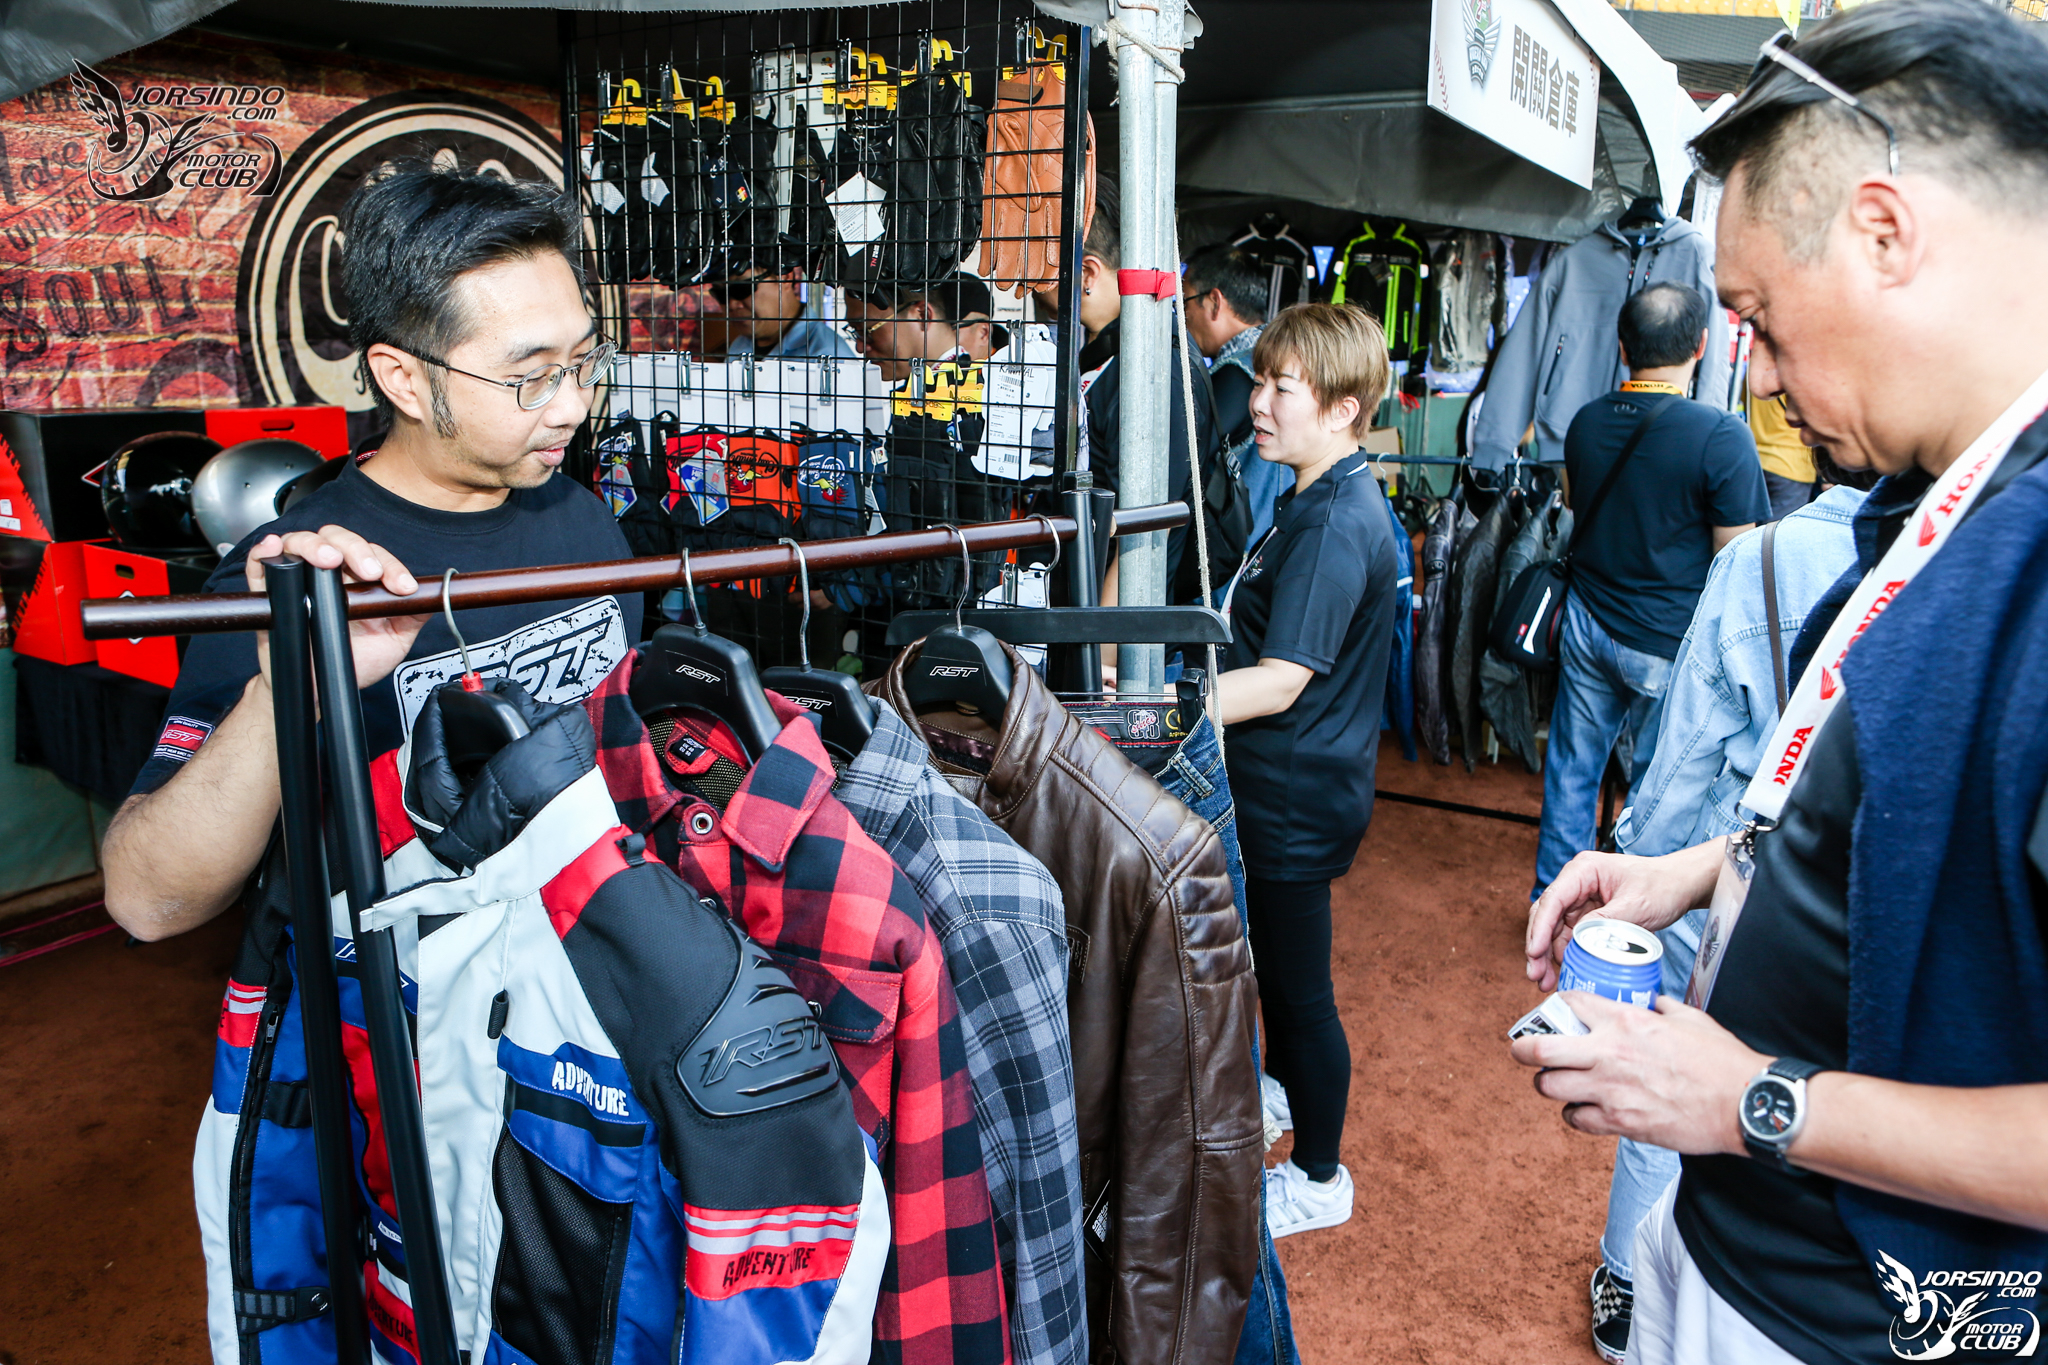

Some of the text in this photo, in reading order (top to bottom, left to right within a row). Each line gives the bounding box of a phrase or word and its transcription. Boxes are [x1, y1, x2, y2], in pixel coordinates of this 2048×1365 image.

[1510, 24, 1580, 138] 開關倉庫
[675, 664, 721, 684] RST
[929, 665, 980, 678] RST
[723, 1247, 816, 1289] ADVENTURE
